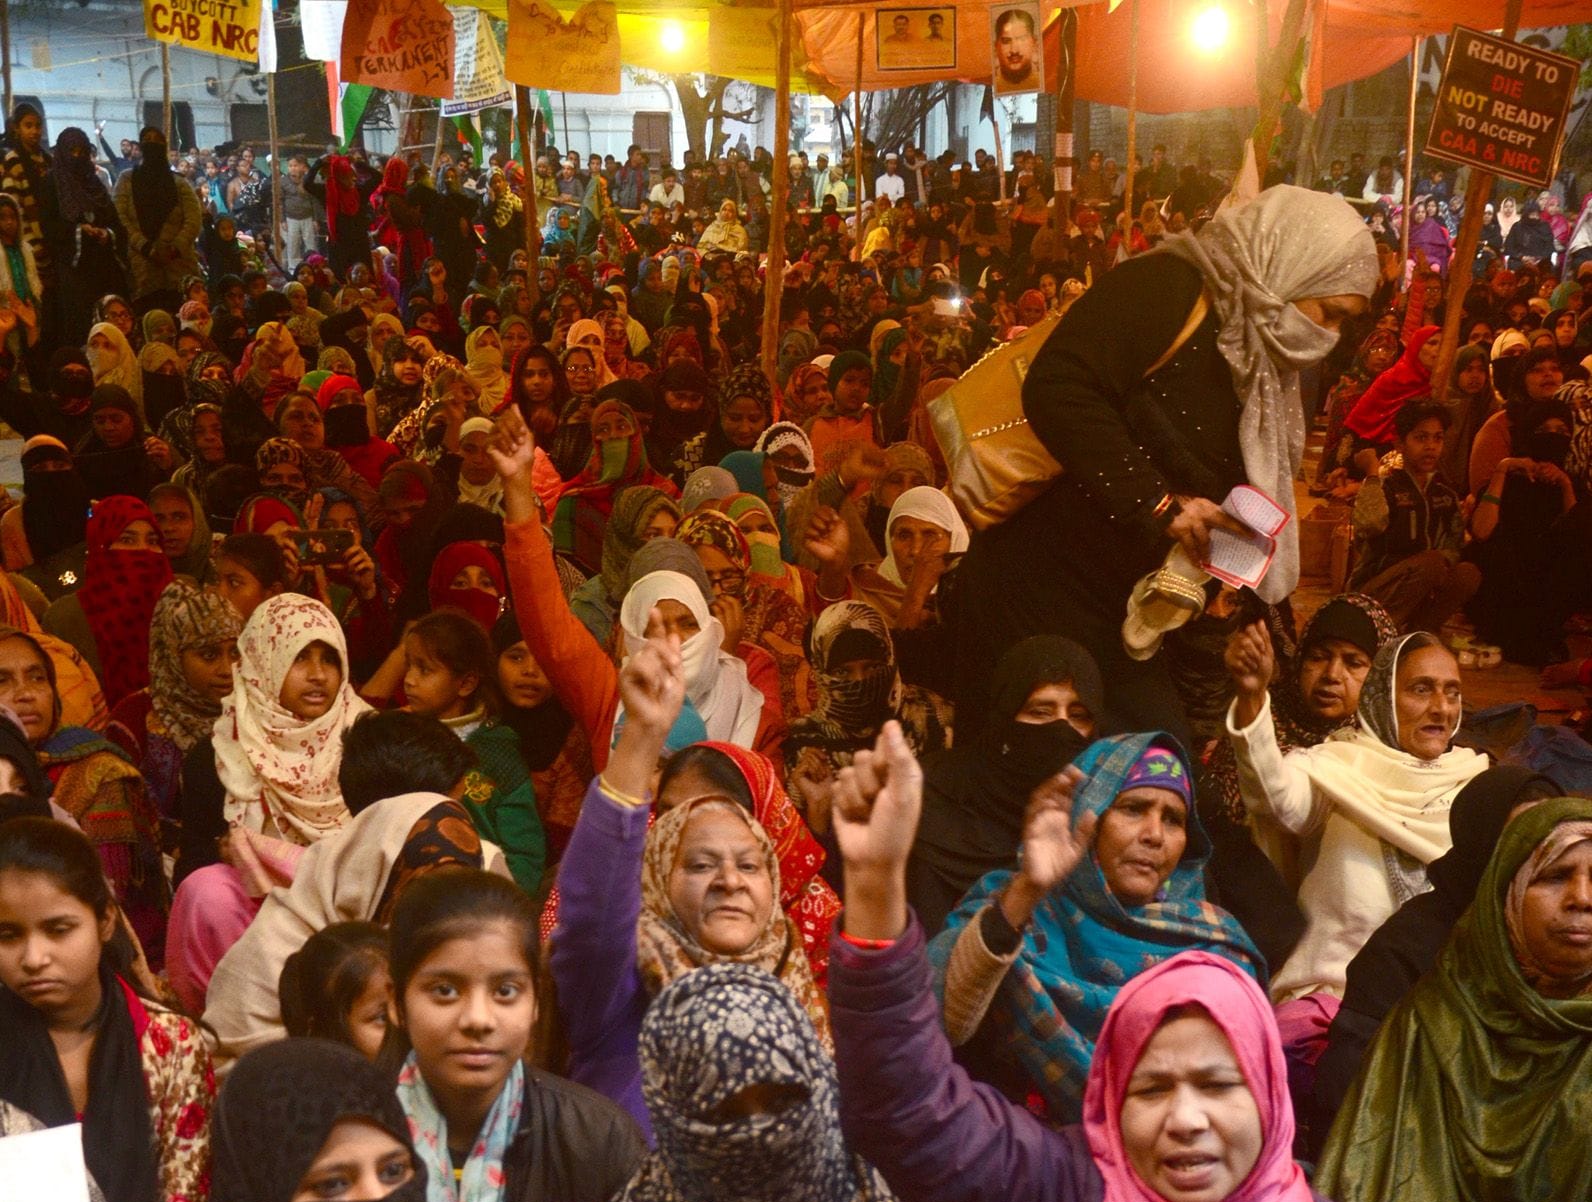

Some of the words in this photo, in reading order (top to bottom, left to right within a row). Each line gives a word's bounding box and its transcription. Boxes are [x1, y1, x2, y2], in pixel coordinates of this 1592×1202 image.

[151, 3, 201, 41] CAB
[212, 20, 259, 54] NRC
[1467, 39, 1531, 74] READY
[1534, 61, 1560, 84] TO
[1490, 74, 1526, 99] DIE
[1447, 86, 1489, 113] NOT
[1491, 100, 1555, 133] READY
[1456, 112, 1477, 131] TO
[1478, 121, 1537, 149] ACCEPT
[1439, 130, 1478, 155] CAA
[1482, 143, 1497, 162] &
[1501, 149, 1542, 175] NRC
